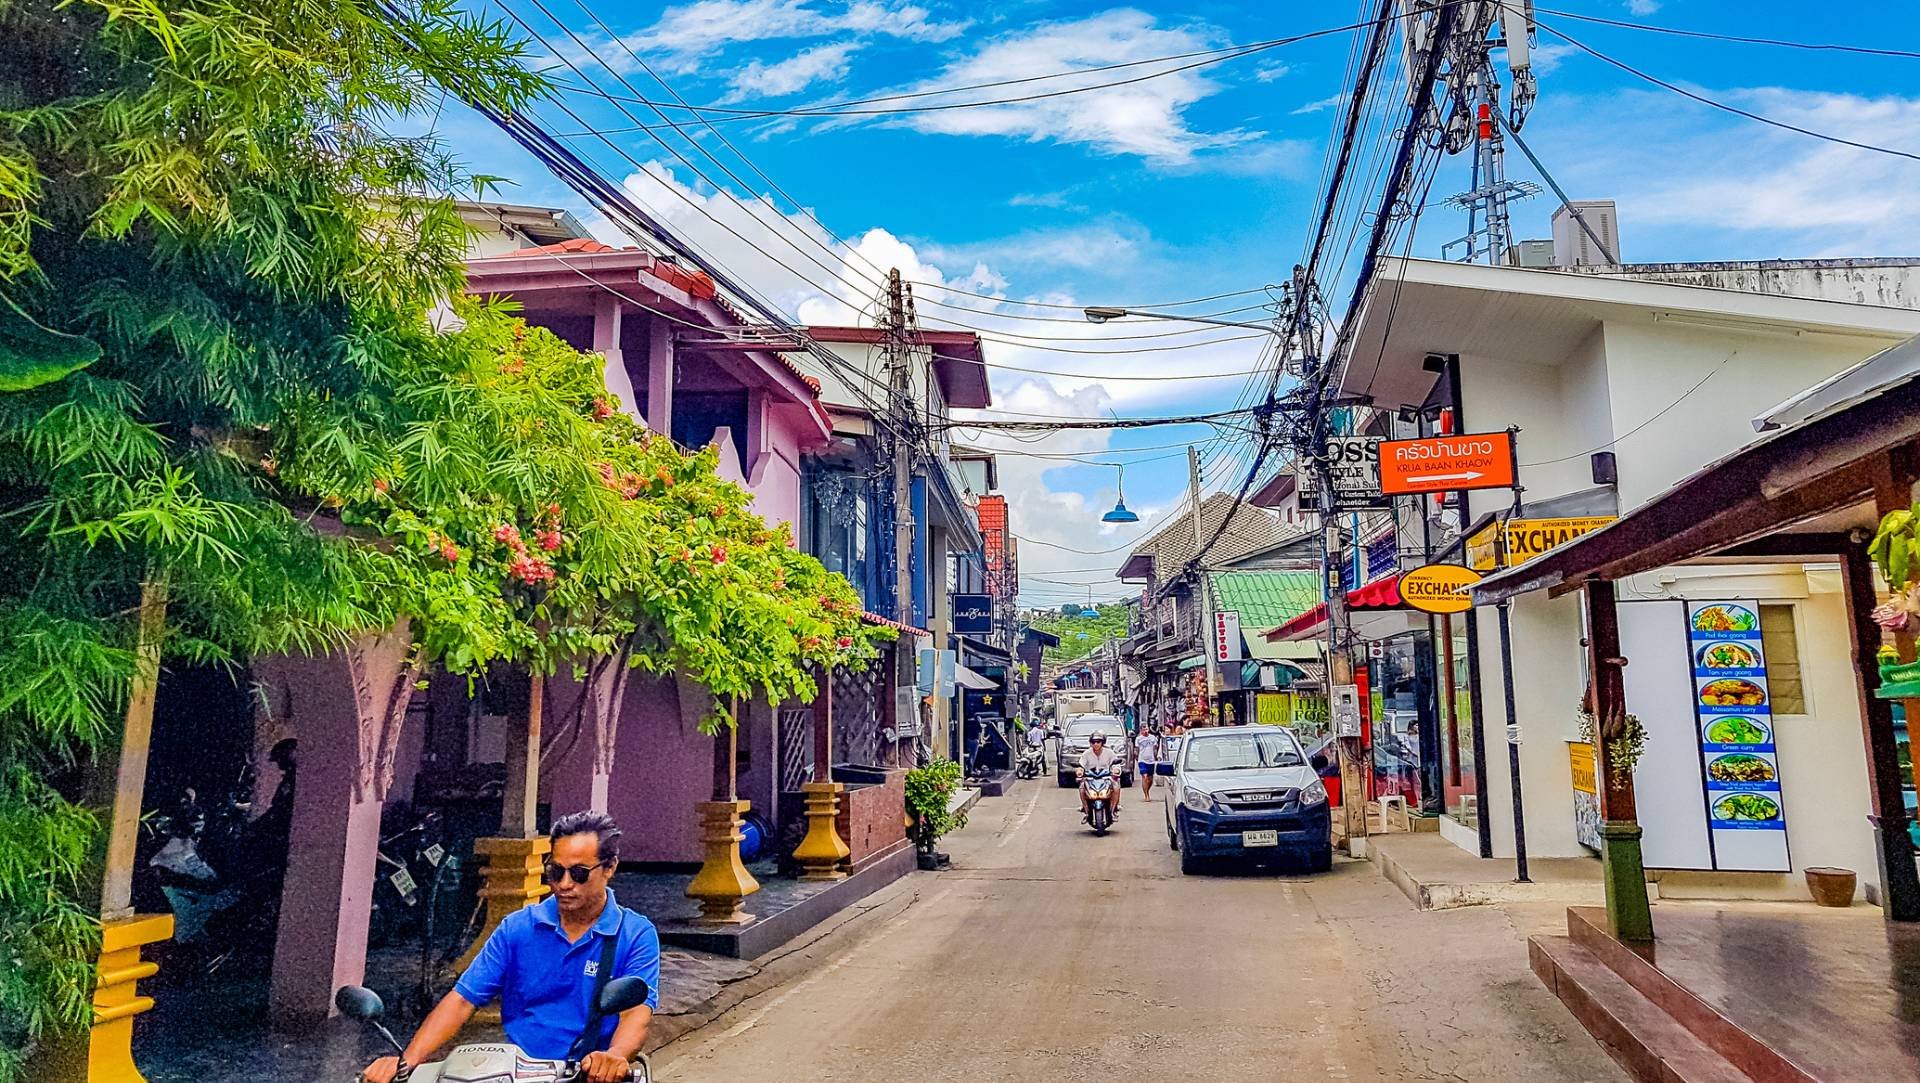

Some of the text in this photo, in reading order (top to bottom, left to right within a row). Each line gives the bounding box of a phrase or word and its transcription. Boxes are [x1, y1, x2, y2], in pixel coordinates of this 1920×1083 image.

[1396, 441, 1493, 460] ครัวบ้านขาว
[1397, 458, 1493, 473] KRUA BAAN KHAOW
[1217, 613, 1228, 660] TATTOO
[1260, 697, 1288, 709] THAI
[1259, 710, 1288, 722] FOOD
